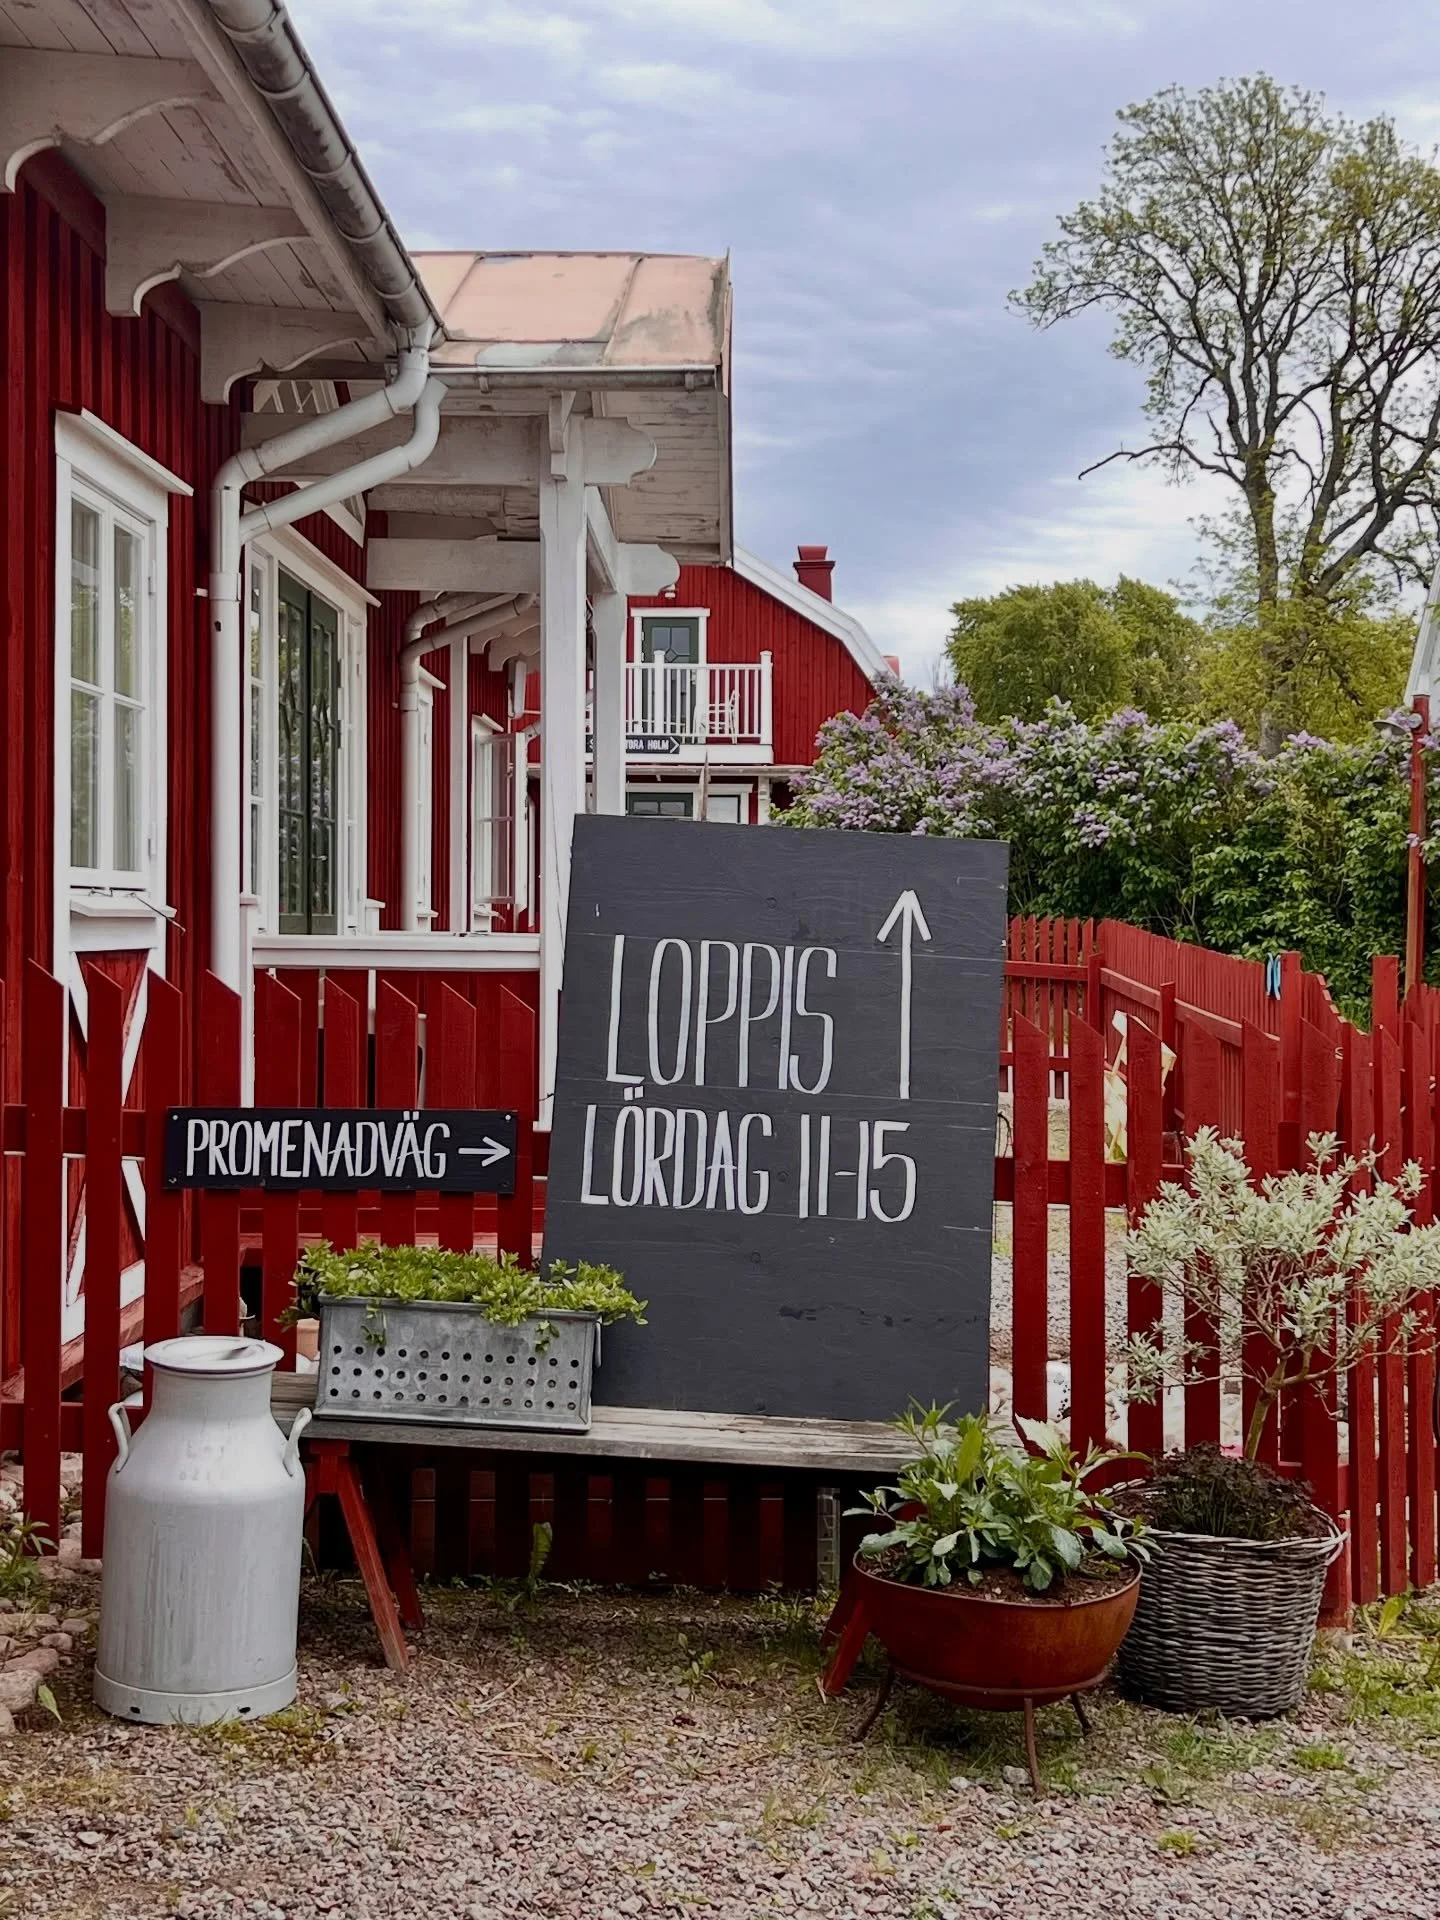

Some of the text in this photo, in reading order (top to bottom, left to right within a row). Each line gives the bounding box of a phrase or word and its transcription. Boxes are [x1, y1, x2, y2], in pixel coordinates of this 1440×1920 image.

[647, 739, 670, 751] HOLM
[606, 934, 838, 1095] LOPPIS
[186, 1110, 451, 1179] PROMENADVÄG
[581, 1085, 917, 1223] LÖRDAG 11-15
